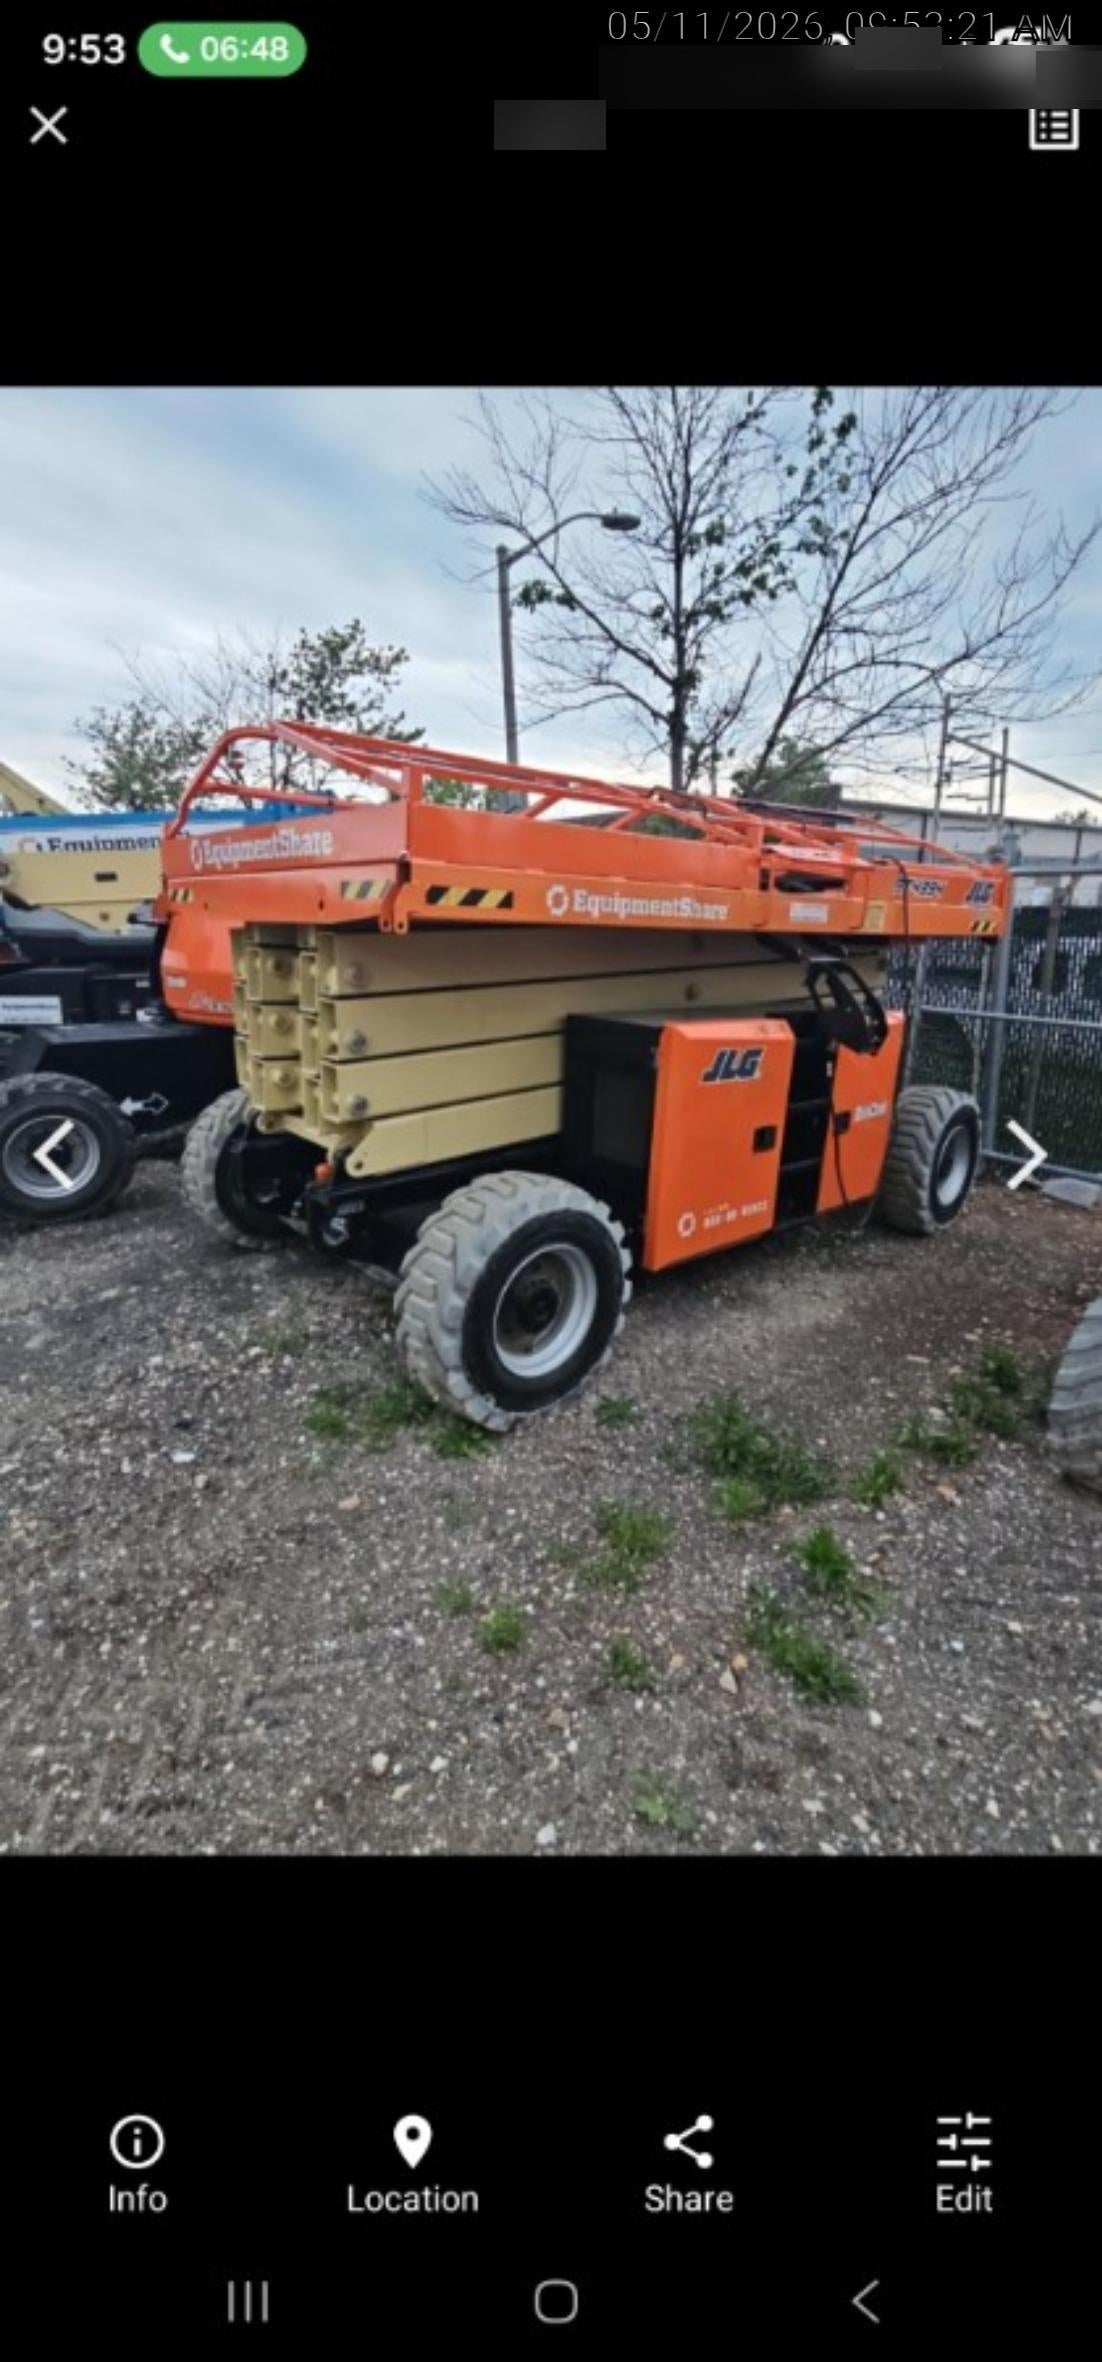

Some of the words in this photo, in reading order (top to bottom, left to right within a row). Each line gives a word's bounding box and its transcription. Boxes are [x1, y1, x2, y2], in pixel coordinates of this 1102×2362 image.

[42, 33, 126, 65] 9:53
[200, 36, 289, 63] 06:48
[47, 831, 165, 852] Equipmen
[203, 826, 333, 870] EquipmentShare
[573, 888, 728, 921] EquipmentShare
[701, 1047, 764, 1083] JLG
[109, 2184, 167, 2212] Info
[348, 2185, 479, 2212] Location
[645, 2184, 733, 2212] Share
[936, 2184, 994, 2212] Edit
